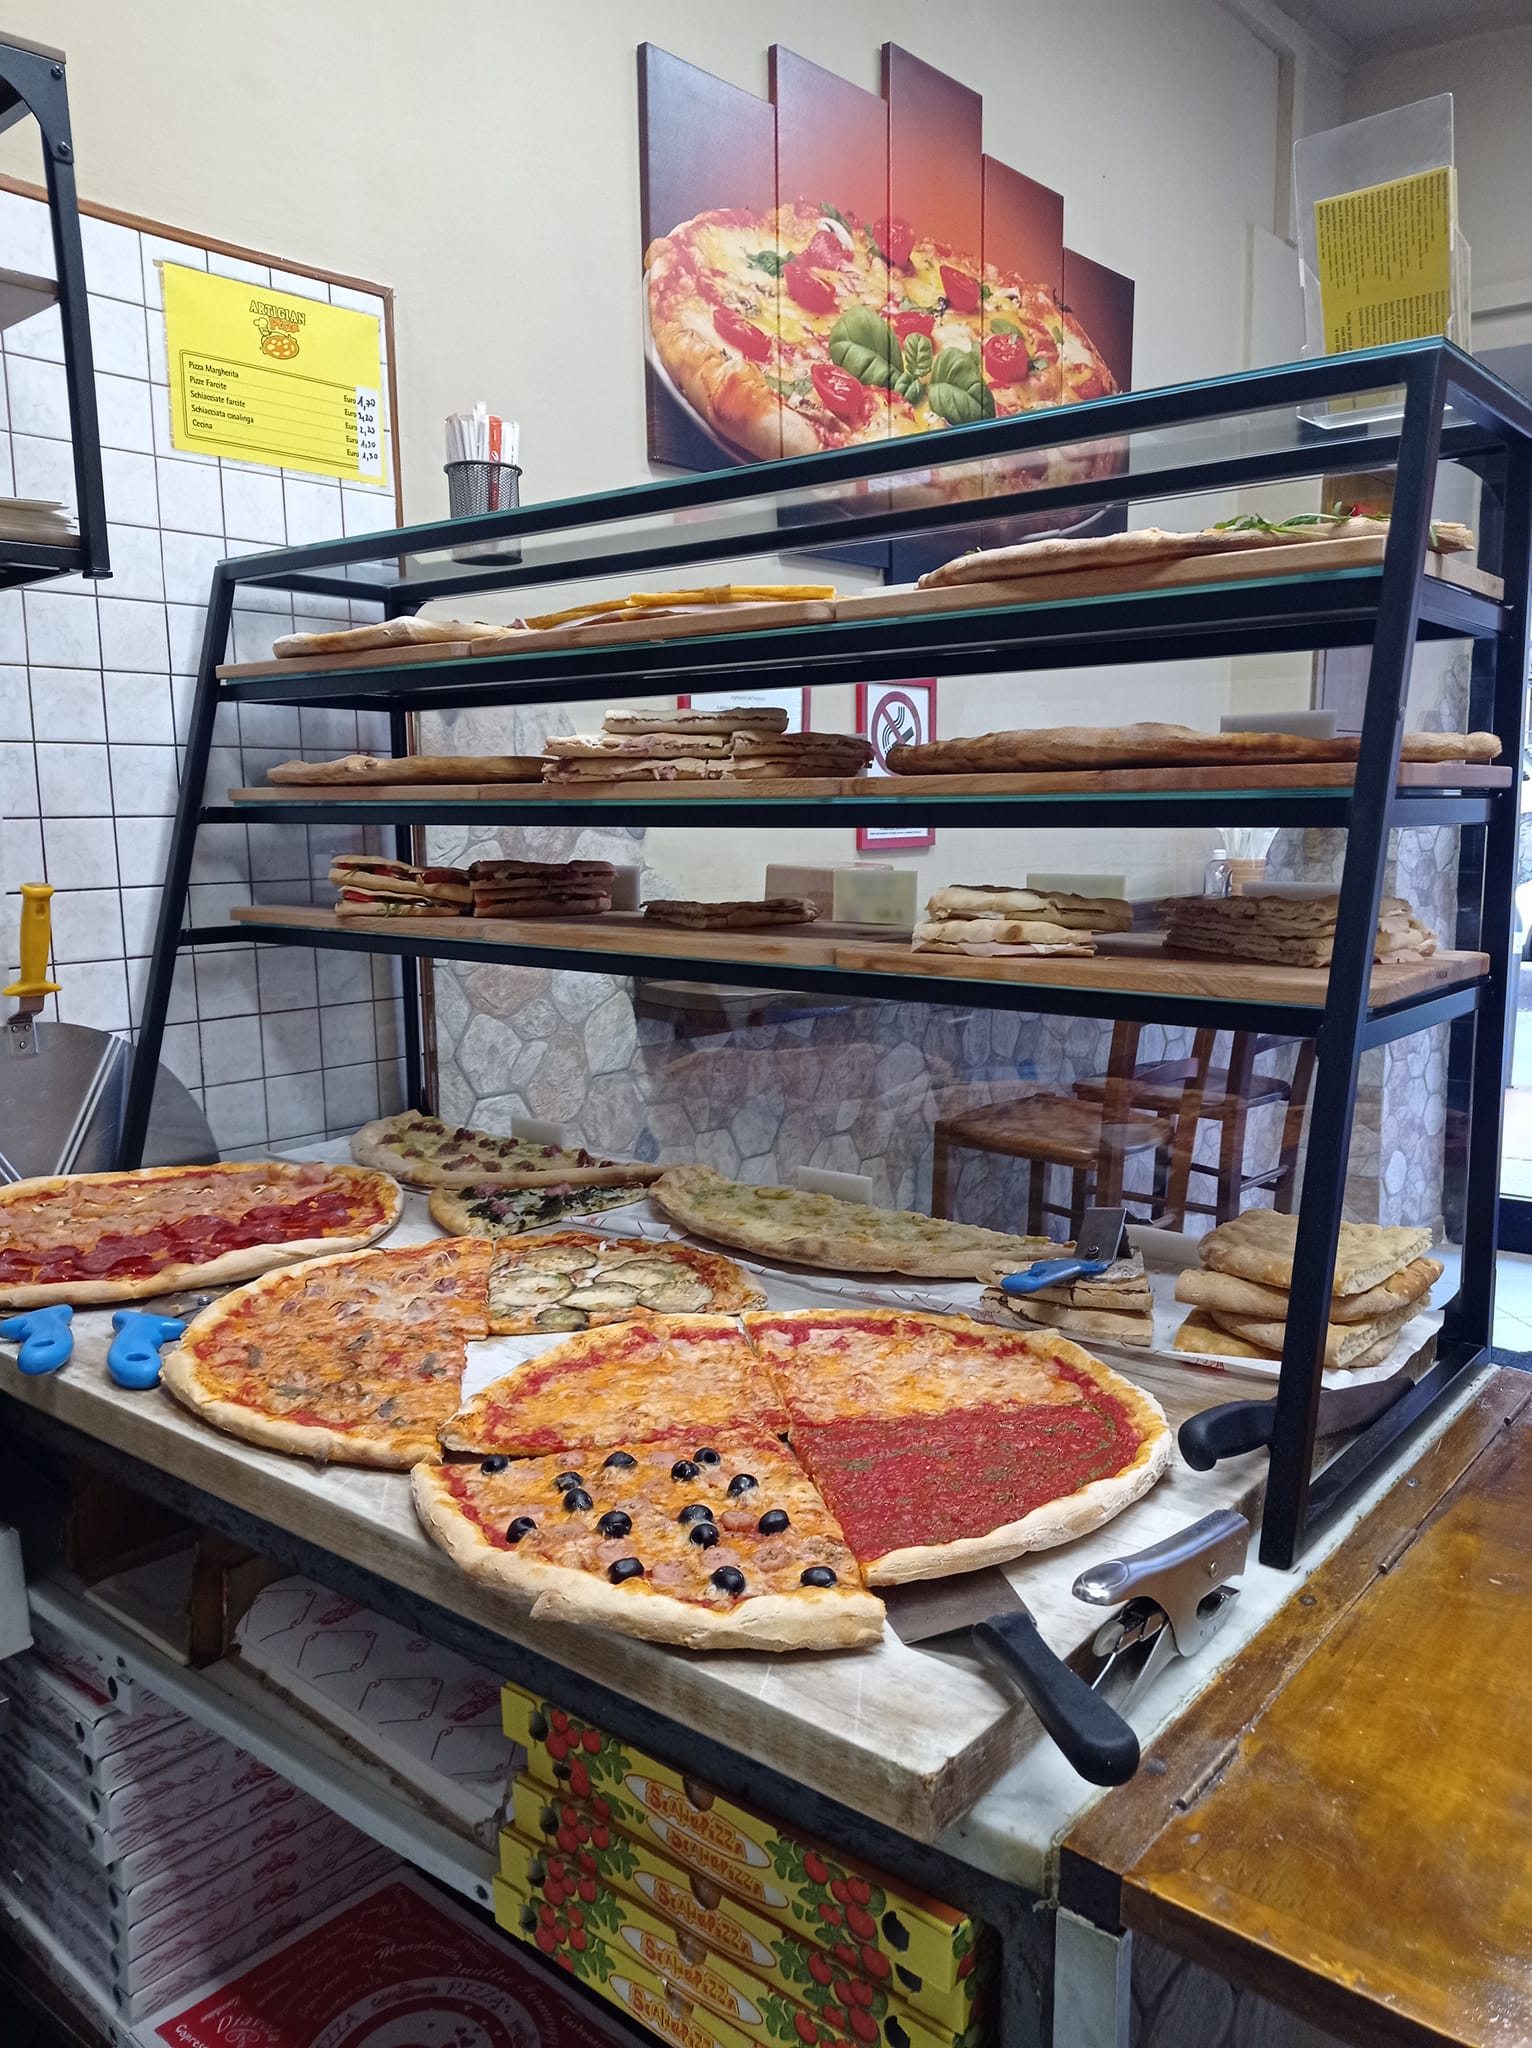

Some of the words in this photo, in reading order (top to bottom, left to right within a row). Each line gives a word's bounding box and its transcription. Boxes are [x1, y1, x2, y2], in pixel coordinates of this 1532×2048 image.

[249, 299, 306, 326] ARTIGIAN
[188, 360, 204, 371] Pizza
[205, 364, 239, 378] Margherita
[189, 375, 204, 385] Pizze
[206, 379, 227, 390] Farcite
[190, 390, 225, 404] Schiacciate
[226, 397, 246, 408] farcite
[343, 394, 356, 404] Euro
[191, 404, 226, 418] Schiacciata
[227, 411, 254, 424] casalinga
[344, 408, 357, 418] Euro
[192, 419, 213, 430] Cecina
[345, 422, 358, 431] Euro
[346, 435, 358, 444] Euro
[347, 448, 359, 458] Euro
